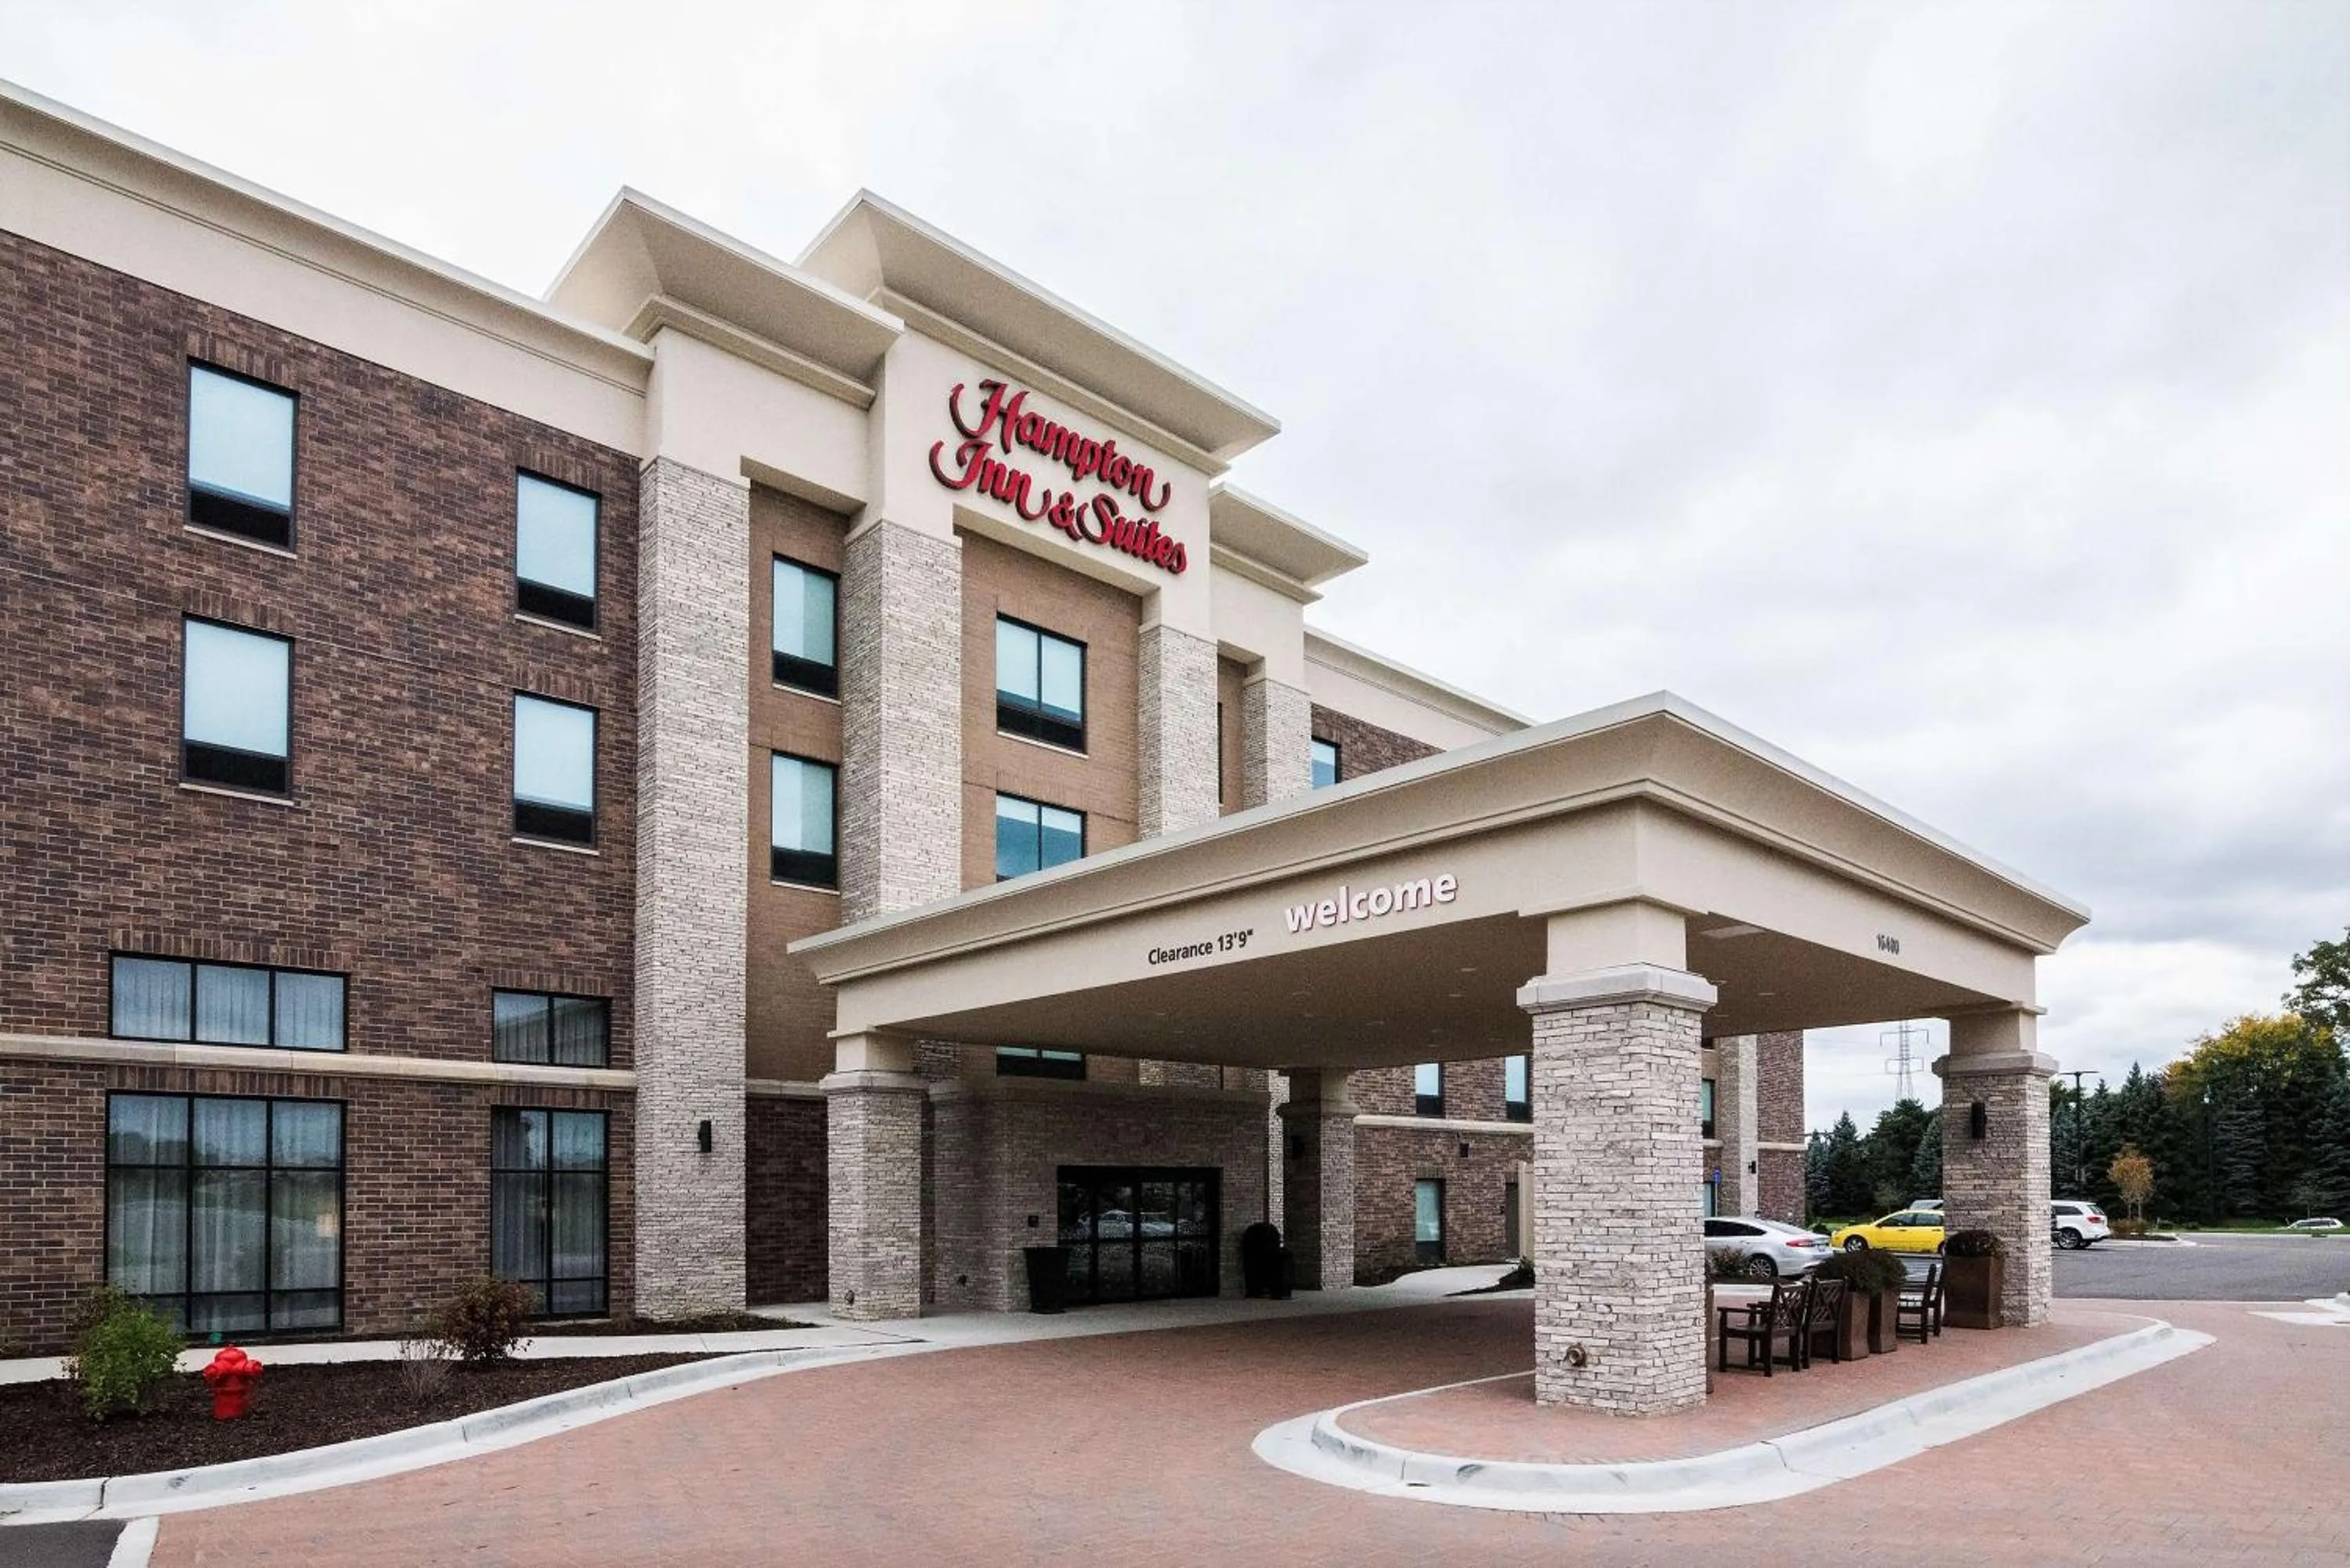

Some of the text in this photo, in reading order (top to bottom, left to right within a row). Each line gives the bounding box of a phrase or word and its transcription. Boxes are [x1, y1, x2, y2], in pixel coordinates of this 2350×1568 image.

[949, 379, 1170, 511] Hampton
[929, 439, 1188, 575] Inn & Suites
[1148, 929, 1254, 966] Clearance 13'9"
[1285, 873, 1458, 934] welcome
